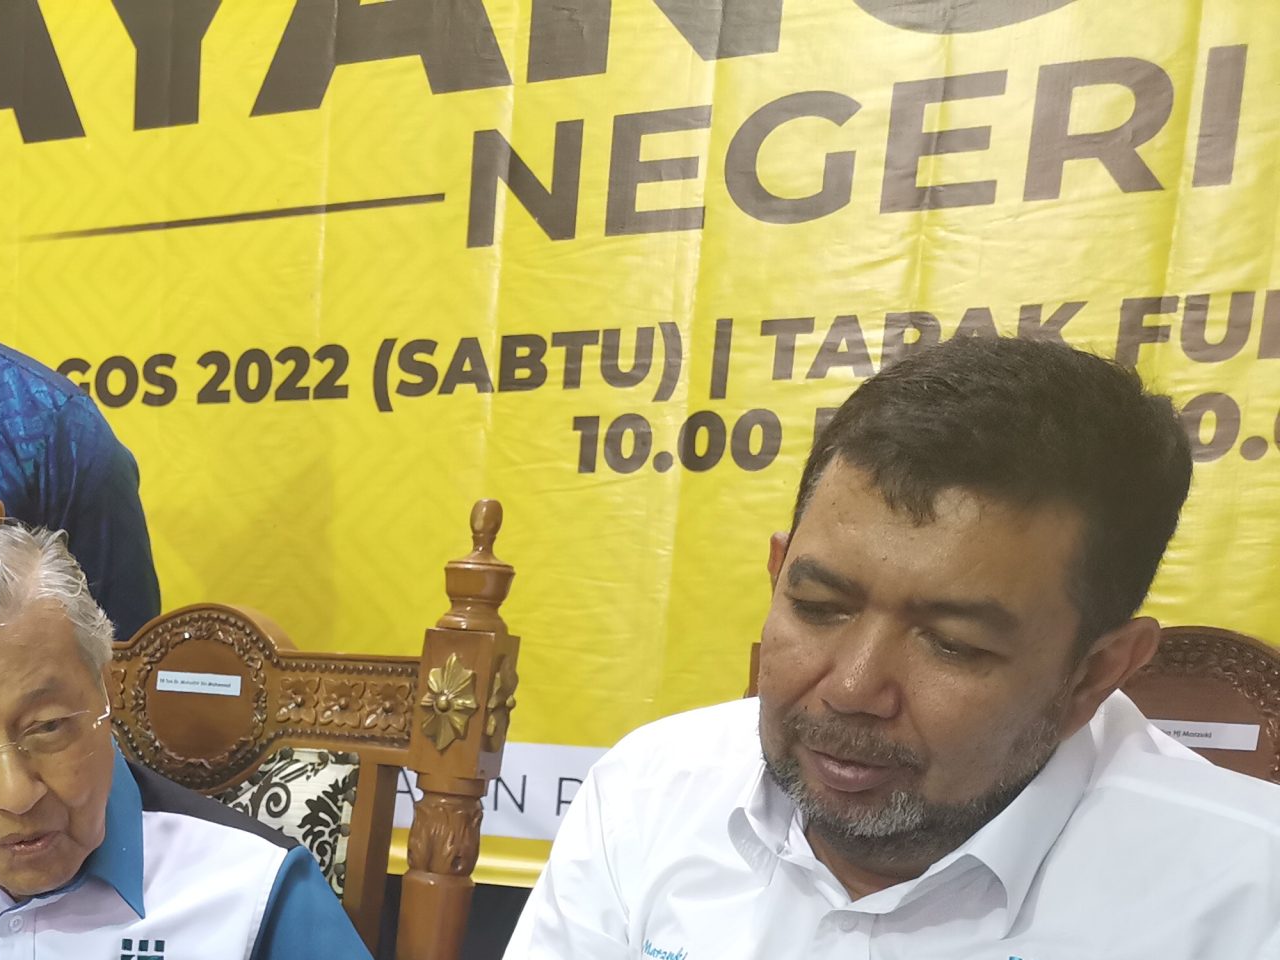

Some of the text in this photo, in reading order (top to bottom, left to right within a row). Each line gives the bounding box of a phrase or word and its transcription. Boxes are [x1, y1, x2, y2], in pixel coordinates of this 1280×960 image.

[467, 44, 1248, 248] NEGERI
[196, 344, 349, 404] 2022
[373, 322, 682, 412] (SABTU)
[573, 408, 782, 473] 10.00
